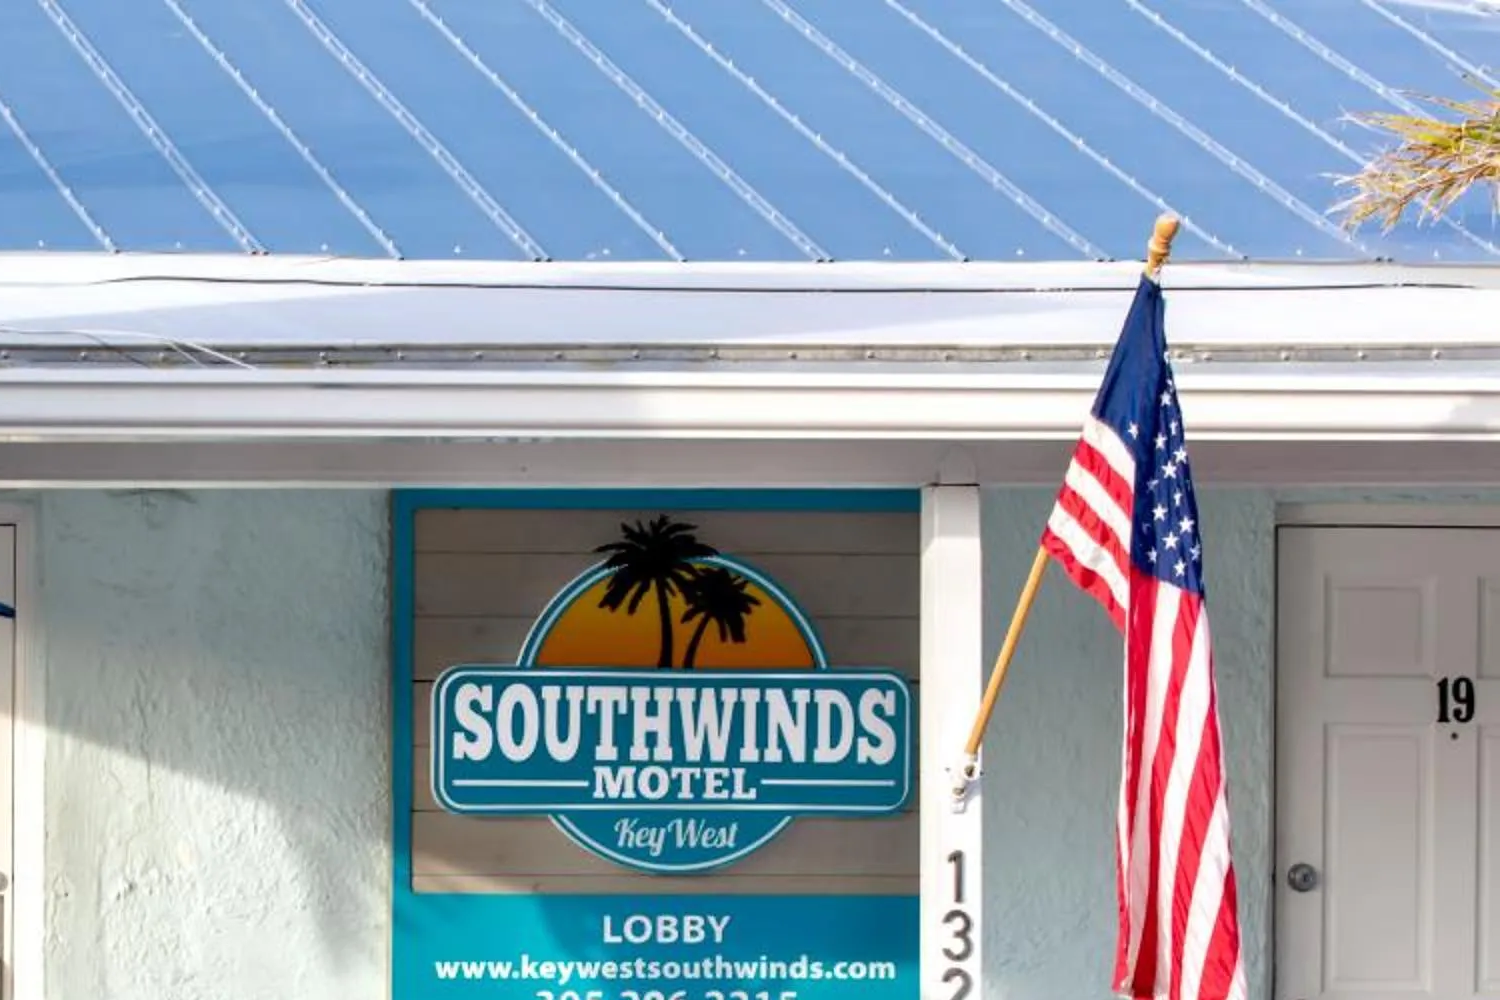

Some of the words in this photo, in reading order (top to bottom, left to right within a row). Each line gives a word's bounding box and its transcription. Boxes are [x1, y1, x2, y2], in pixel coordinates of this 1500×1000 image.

[1437, 676, 1475, 723] 19
[451, 681, 897, 766] SOUTHWINDS
[592, 765, 757, 800] MOTEL
[613, 817, 667, 857] Key
[667, 818, 739, 848] West
[602, 914, 731, 944] LOBBY
[435, 954, 896, 985] www.keywestsouthwinds.com
